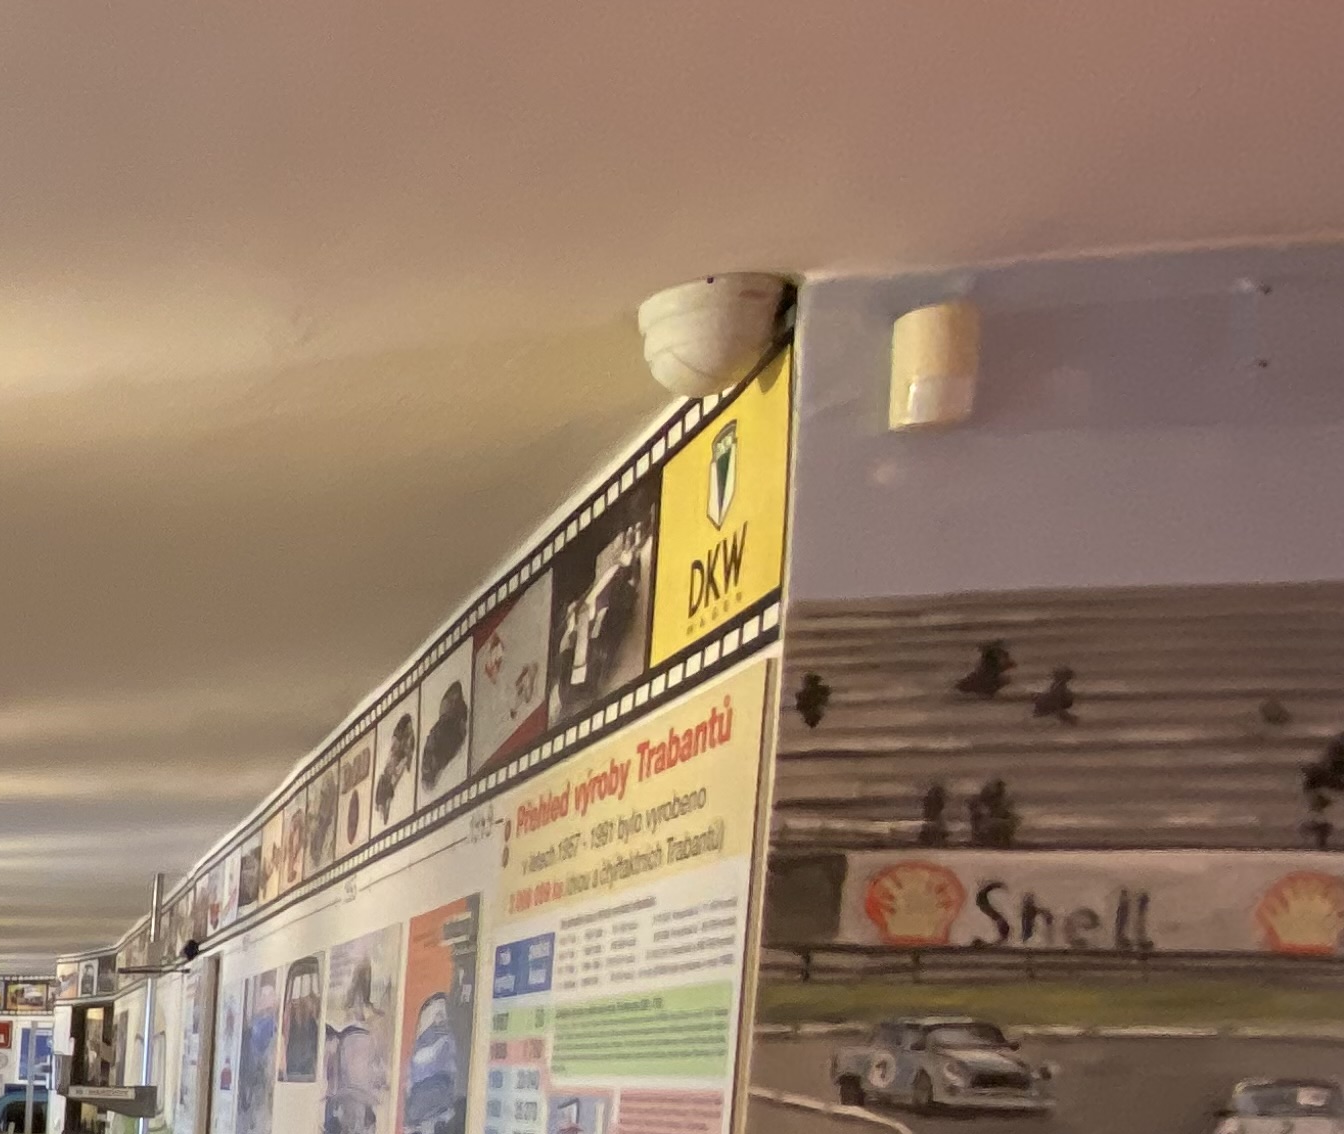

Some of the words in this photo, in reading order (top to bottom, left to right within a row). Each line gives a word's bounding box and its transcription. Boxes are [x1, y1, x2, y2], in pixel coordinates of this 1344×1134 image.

[688, 520, 748, 619] DKW
[636, 694, 733, 782] Trabantů
[975, 880, 1154, 950] Shell
